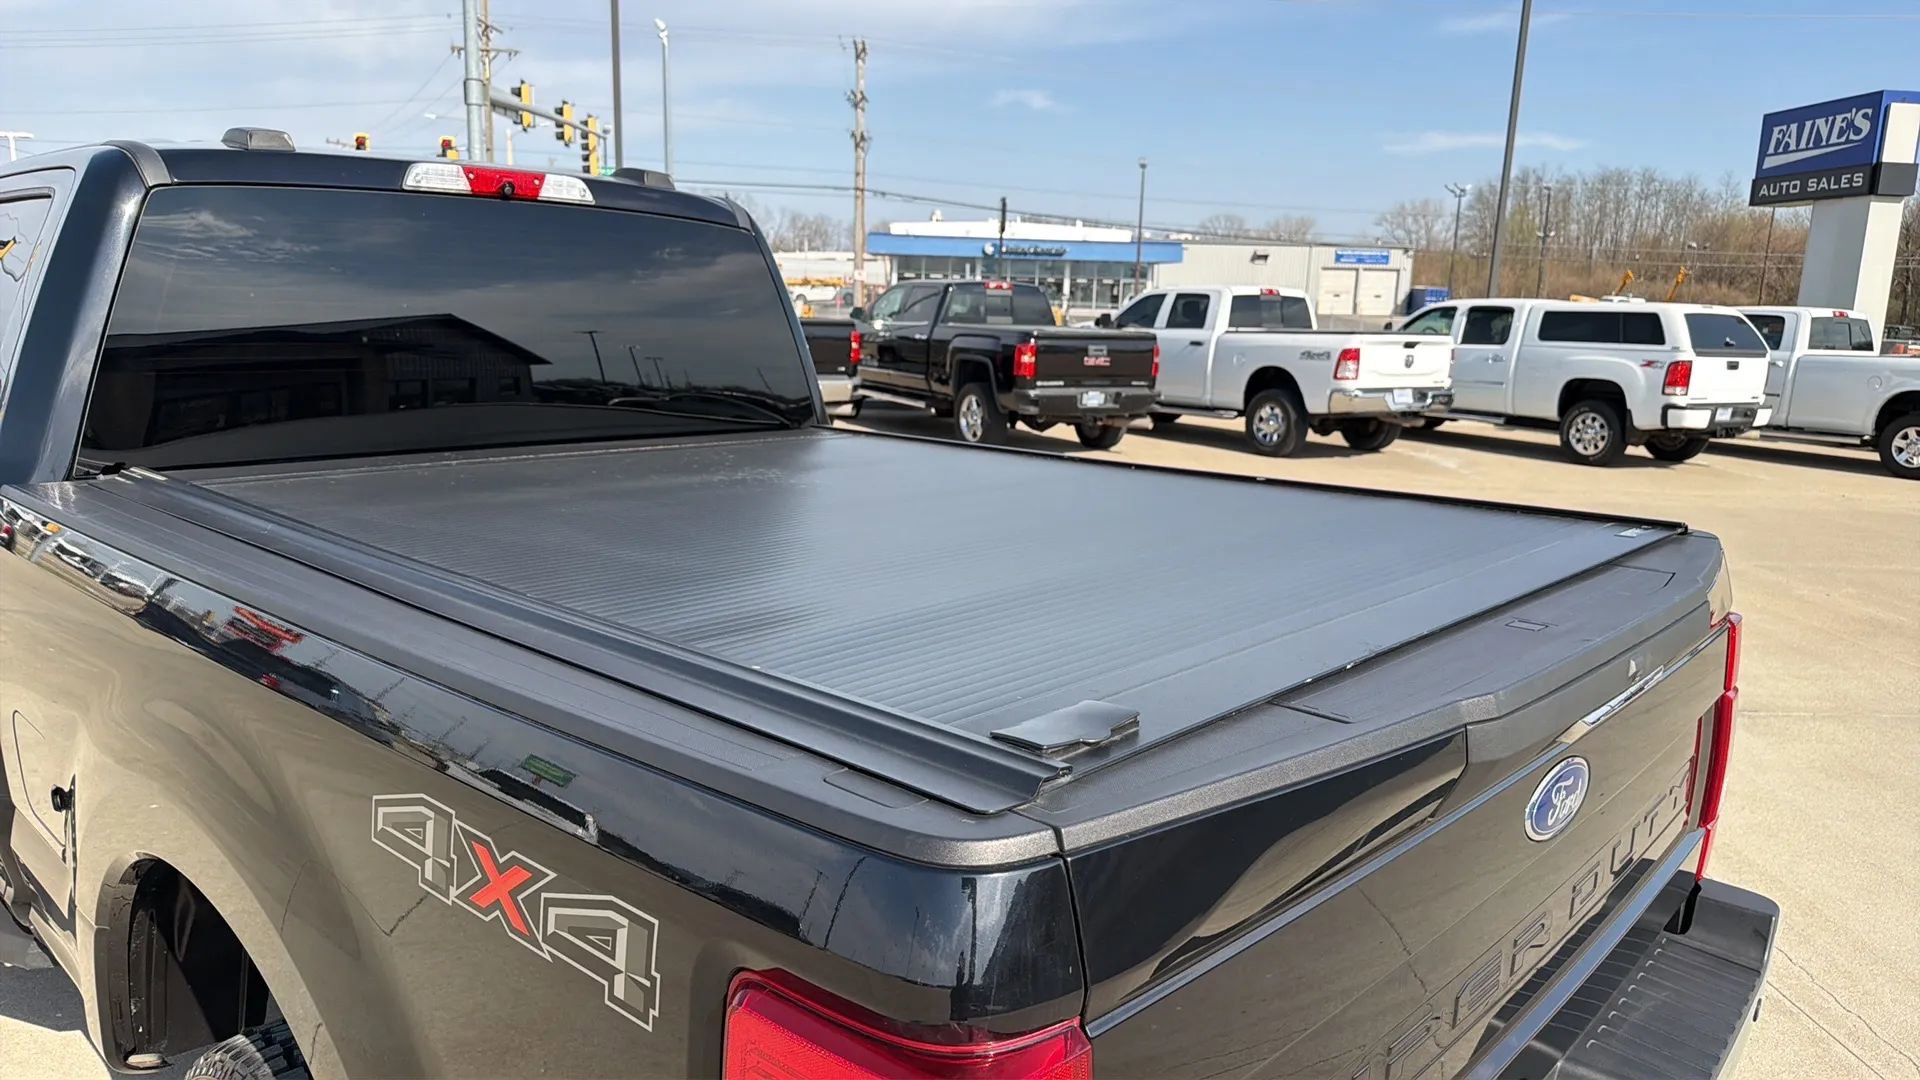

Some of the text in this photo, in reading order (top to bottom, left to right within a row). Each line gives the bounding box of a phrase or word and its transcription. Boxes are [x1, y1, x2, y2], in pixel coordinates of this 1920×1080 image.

[1766, 107, 1873, 155] FAINE'S
[1758, 172, 1864, 198] AUTO SALES
[1083, 356, 1111, 366] GMC
